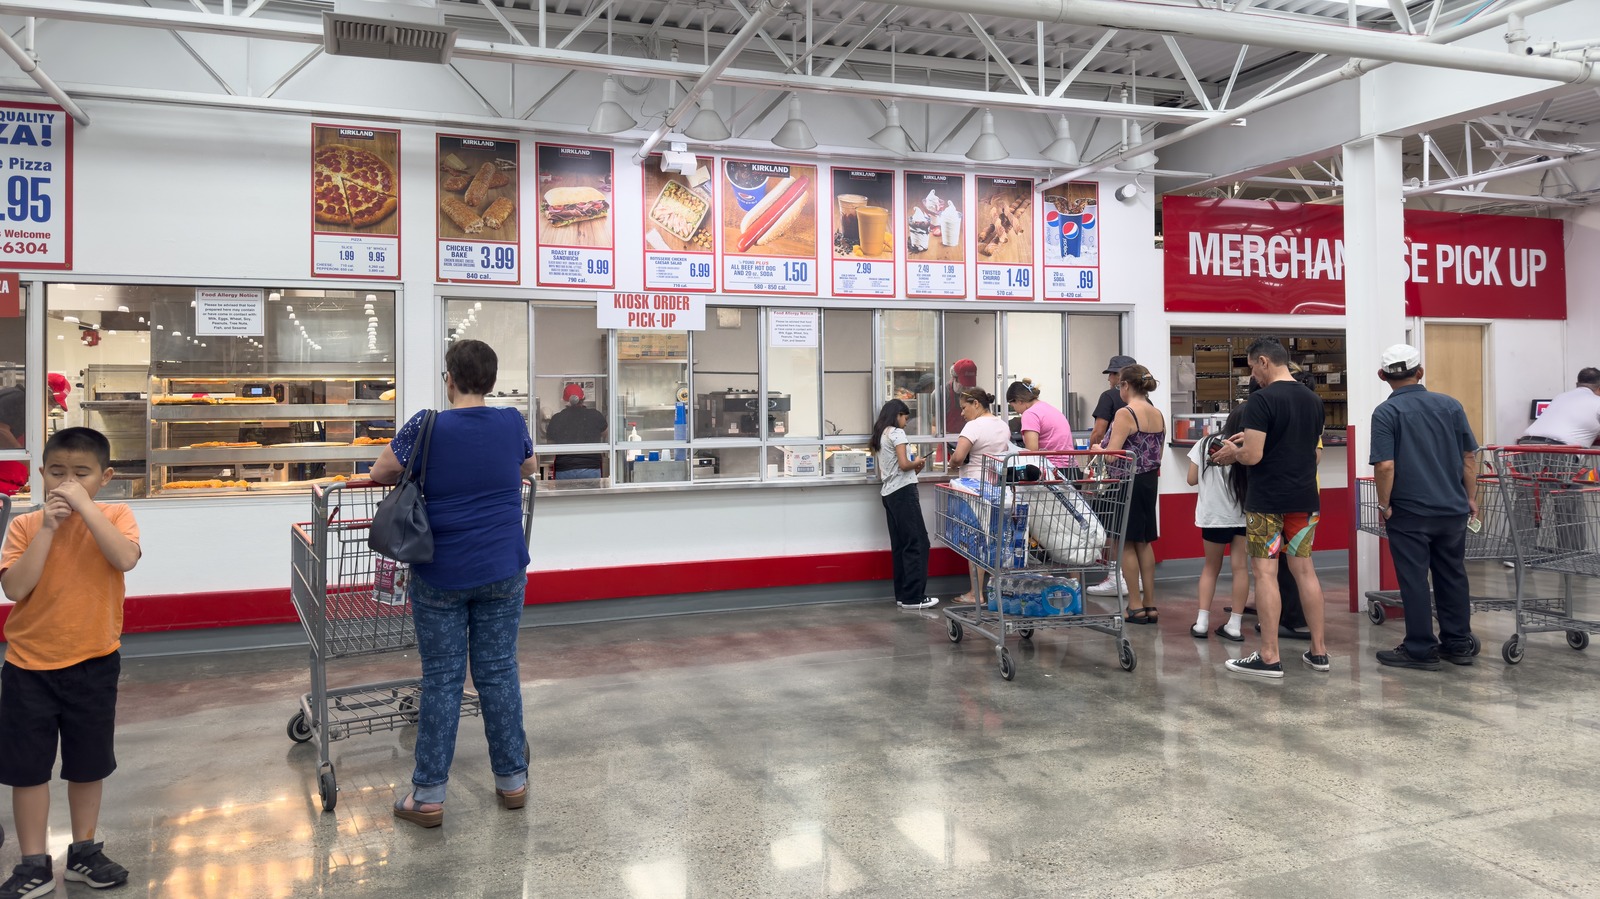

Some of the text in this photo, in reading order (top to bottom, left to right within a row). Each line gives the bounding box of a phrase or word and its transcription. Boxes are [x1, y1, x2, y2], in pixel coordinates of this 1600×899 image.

[0, 111, 55, 124] QUALITY
[340, 129, 373, 137] KIRKLAND
[462, 139, 494, 147] KIRKLAND
[9, 157, 52, 171] Pizza
[751, 164, 789, 174] KIRKLAND
[4, 229, 51, 240] Welcome
[446, 244, 473, 252] CHICKEN
[339, 250, 355, 261] 1.99
[368, 252, 385, 262] 9.95
[481, 246, 514, 269] 3.99
[587, 259, 609, 274] 9.99
[690, 263, 710, 277] 6.99
[783, 261, 807, 282] 1.50
[856, 263, 872, 274] 2.99
[918, 264, 929, 273] 2.49
[944, 265, 954, 273] 1.99
[1436, 244, 1503, 286] PICK
[1509, 248, 1547, 287] UP
[1006, 268, 1029, 287] 1.49
[1076, 270, 1093, 289] .69
[614, 293, 690, 310] KIOSK ORDER
[628, 312, 676, 328] PICK-UP
